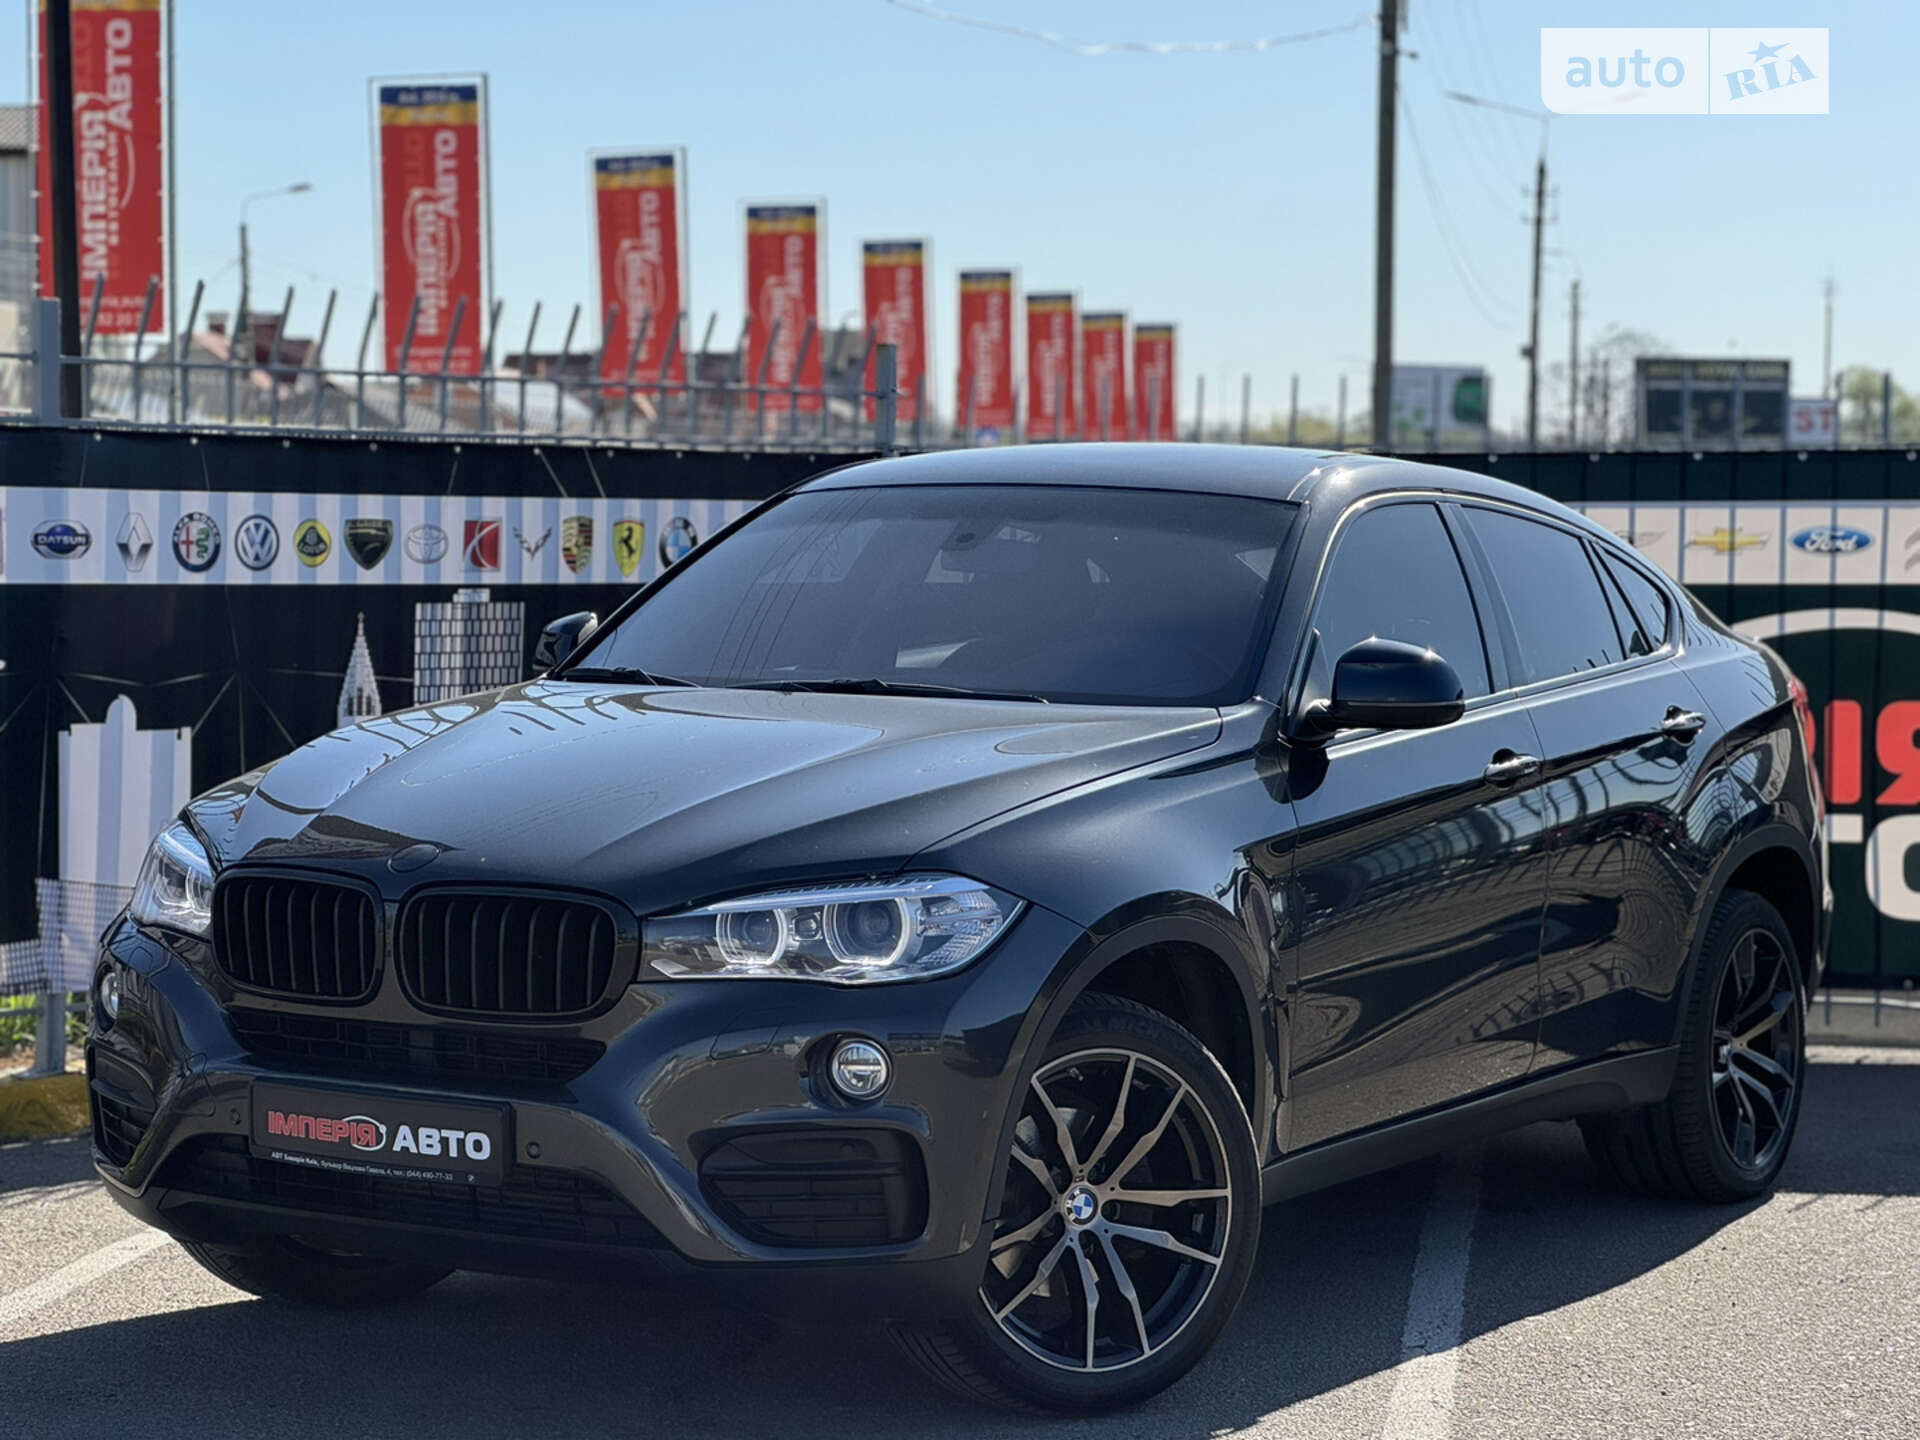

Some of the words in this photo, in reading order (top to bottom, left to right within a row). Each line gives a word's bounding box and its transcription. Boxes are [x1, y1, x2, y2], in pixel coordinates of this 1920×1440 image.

[106, 18, 133, 130] АВТО
[37, 535, 87, 545] DATSUN
[1804, 530, 1860, 552] Ford
[267, 1110, 377, 1147] ІМПЕРІЯ
[392, 1125, 491, 1161] АВТО
